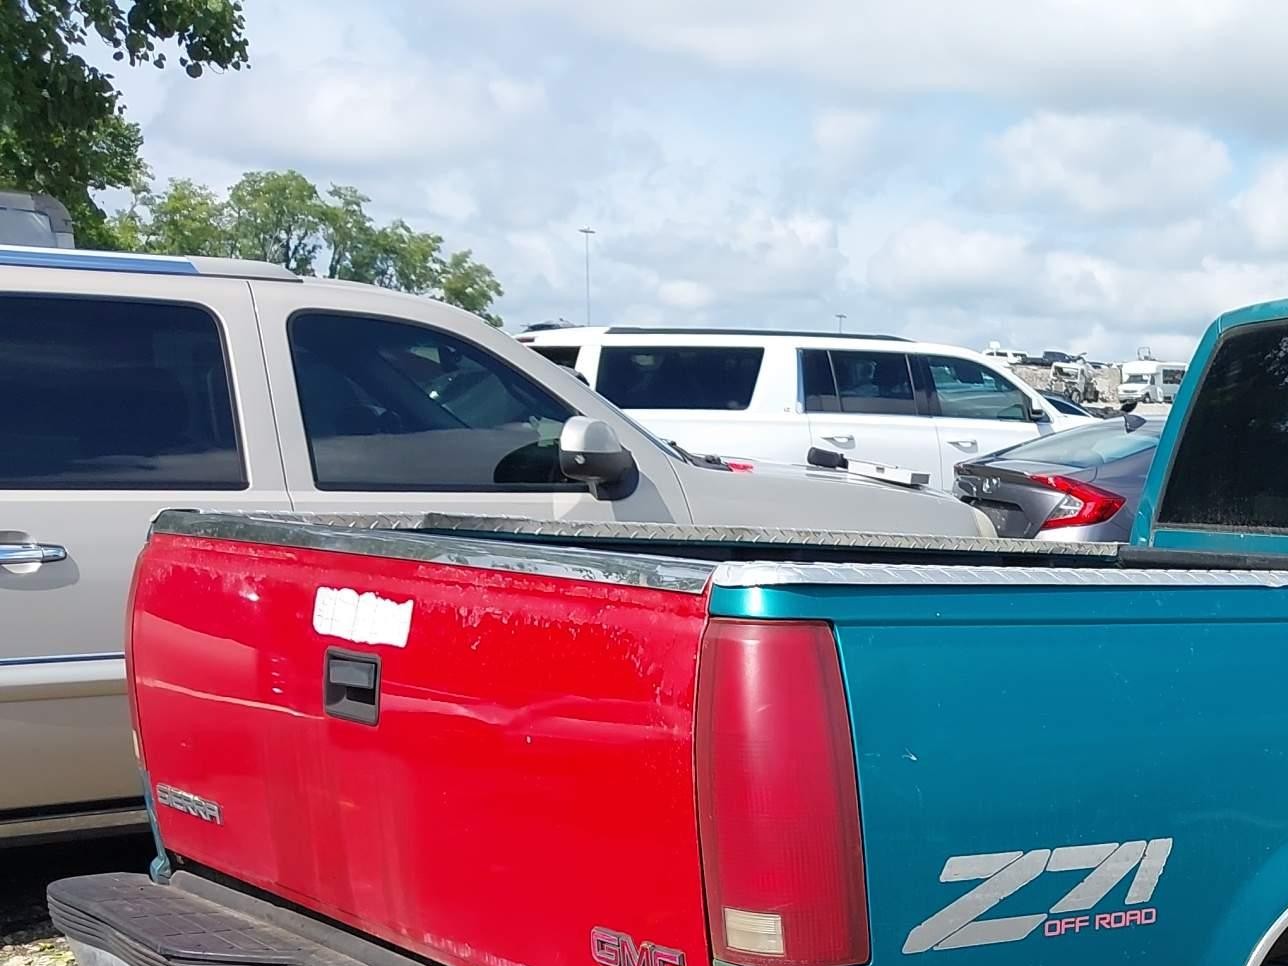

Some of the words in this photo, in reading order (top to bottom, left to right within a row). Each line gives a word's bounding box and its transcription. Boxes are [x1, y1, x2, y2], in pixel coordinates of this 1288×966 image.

[156, 782, 222, 825] SIERRA
[902, 837, 1173, 955] Z71
[1044, 914, 1090, 938] OFF
[1094, 907, 1157, 931] ROAD
